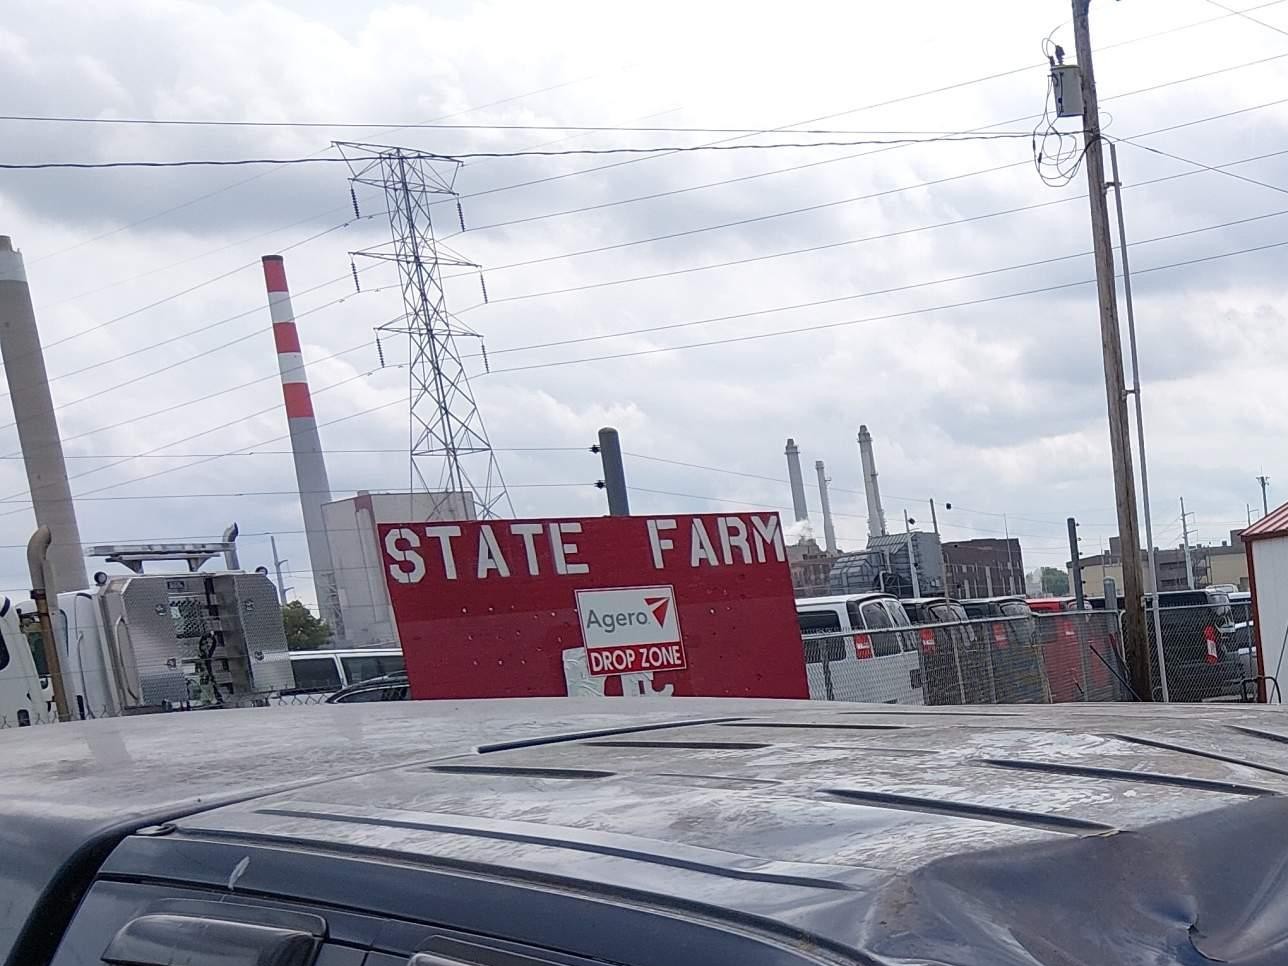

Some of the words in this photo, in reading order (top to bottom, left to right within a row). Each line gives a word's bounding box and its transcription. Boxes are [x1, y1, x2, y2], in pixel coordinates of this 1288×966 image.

[384, 521, 590, 585] STATE
[647, 515, 786, 571] FARM
[586, 607, 648, 634] Agero
[590, 648, 636, 672] DROP
[639, 645, 682, 667] ZONE
